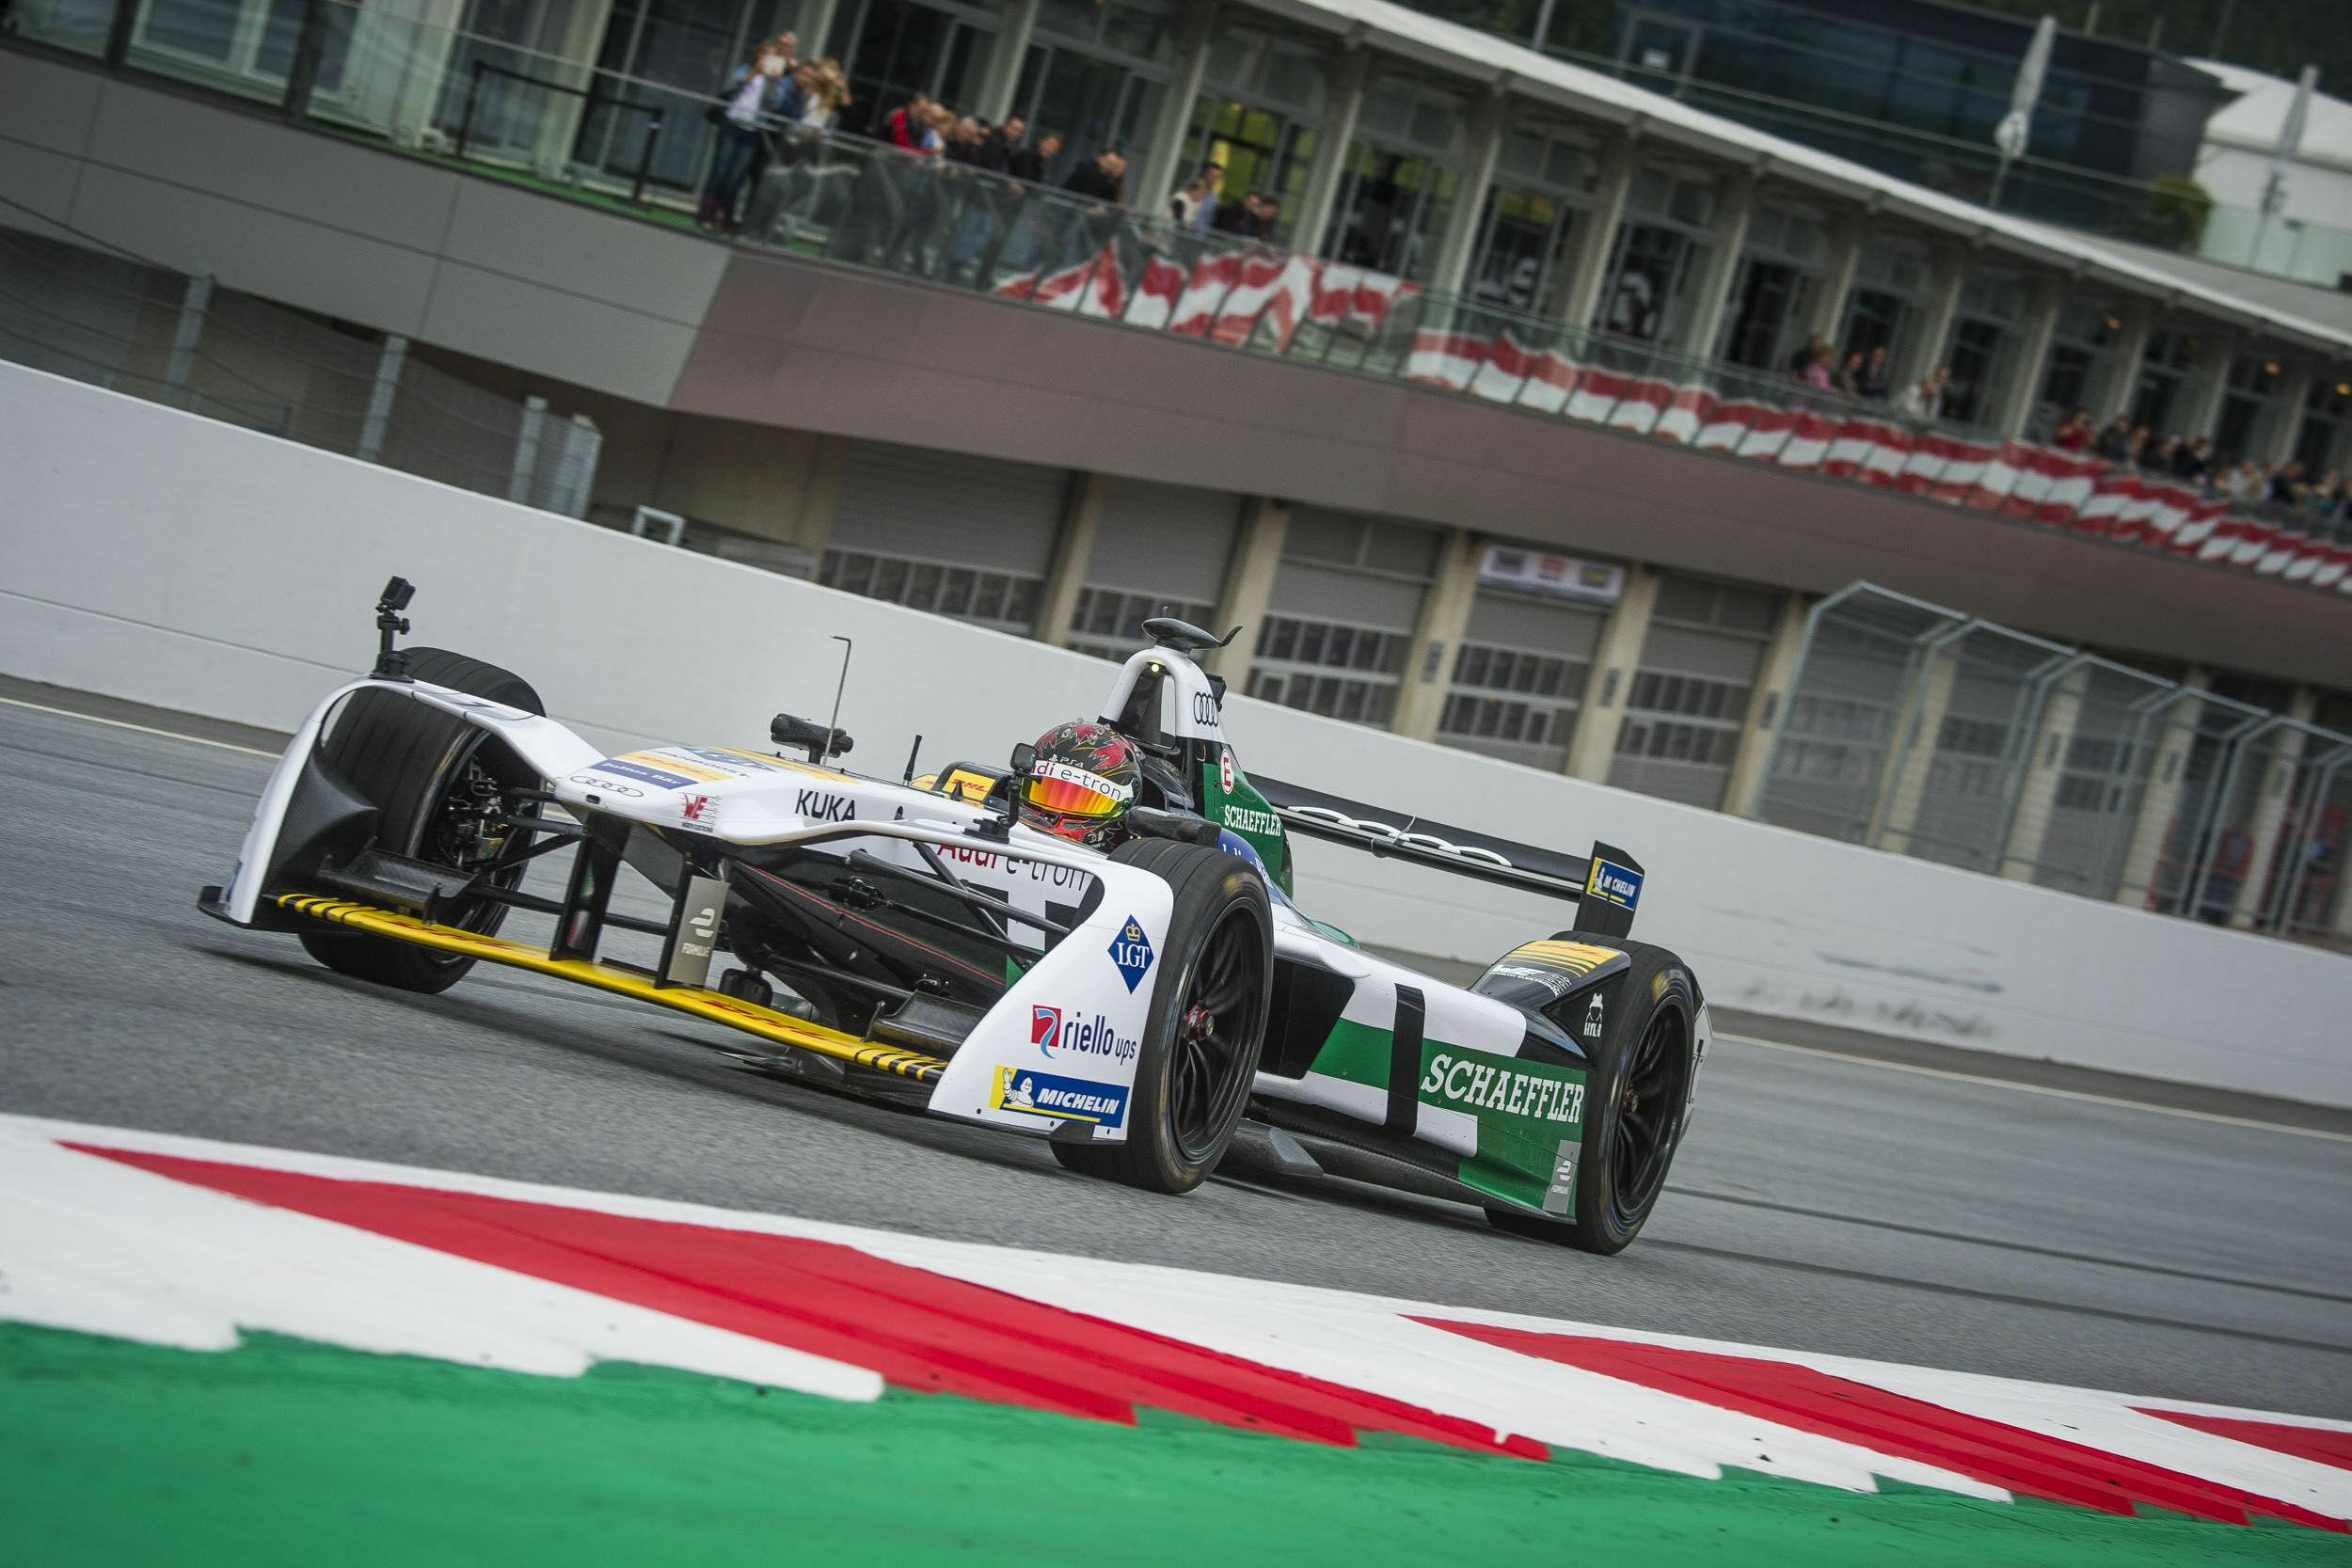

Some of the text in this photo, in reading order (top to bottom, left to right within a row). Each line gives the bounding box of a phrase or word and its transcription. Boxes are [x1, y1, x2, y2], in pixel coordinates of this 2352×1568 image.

[1060, 768, 1121, 800] e-tron
[795, 788, 855, 823] KUKA
[1224, 804, 1281, 837] SCHAEFFLER
[1602, 875, 1637, 898] MCHELIN
[1116, 942, 1150, 970] LGT
[1062, 1011, 1137, 1066] riello ups
[1037, 1087, 1120, 1116] MICHELIN
[1421, 1053, 1585, 1124] SCHAEFFLER
